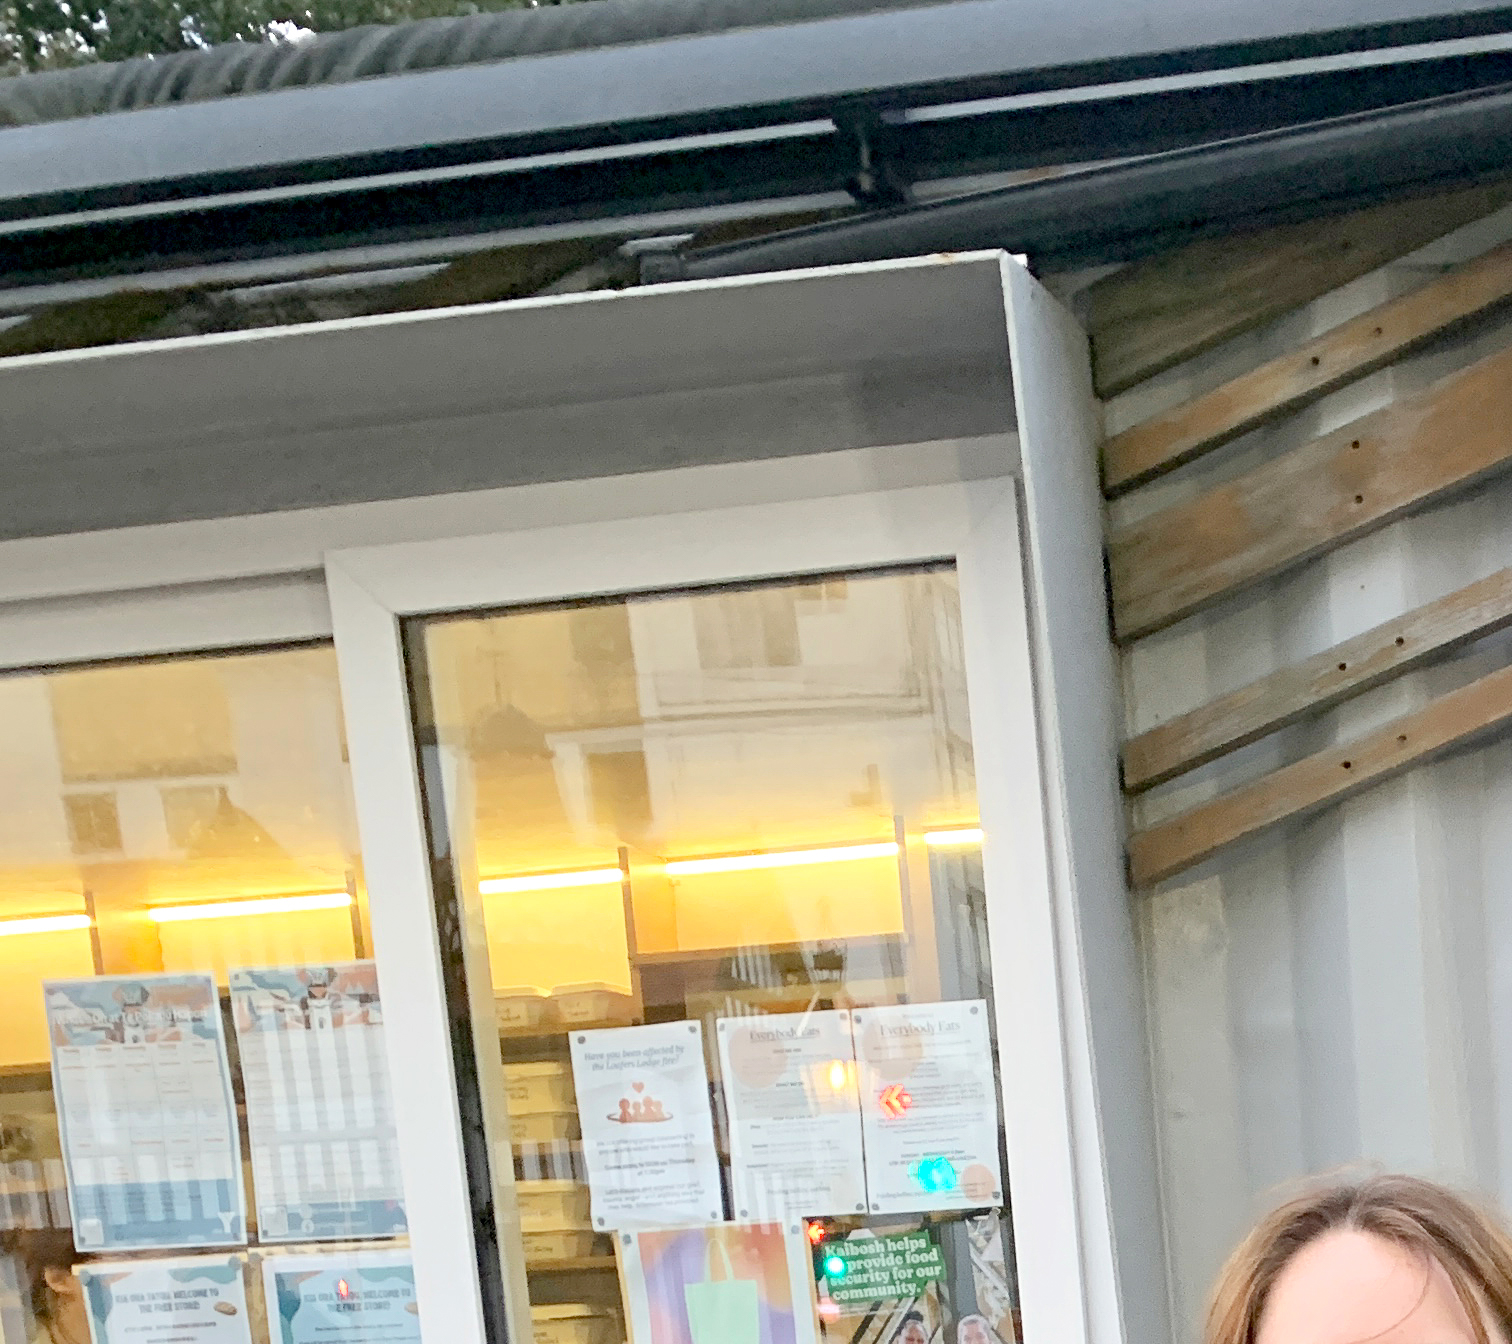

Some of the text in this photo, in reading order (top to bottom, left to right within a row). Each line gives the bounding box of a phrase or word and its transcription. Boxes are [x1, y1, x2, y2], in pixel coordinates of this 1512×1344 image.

[750, 1027, 798, 1041] Everybod
[880, 1021, 934, 1036] Everybody
[584, 1044, 685, 1061] Have you been affected by
[825, 1236, 927, 1257] Kaibosh helps
[846, 1247, 939, 1273] provide food
[892, 1266, 914, 1281] for
[916, 1265, 942, 1279] our
[831, 1280, 922, 1301] community.
